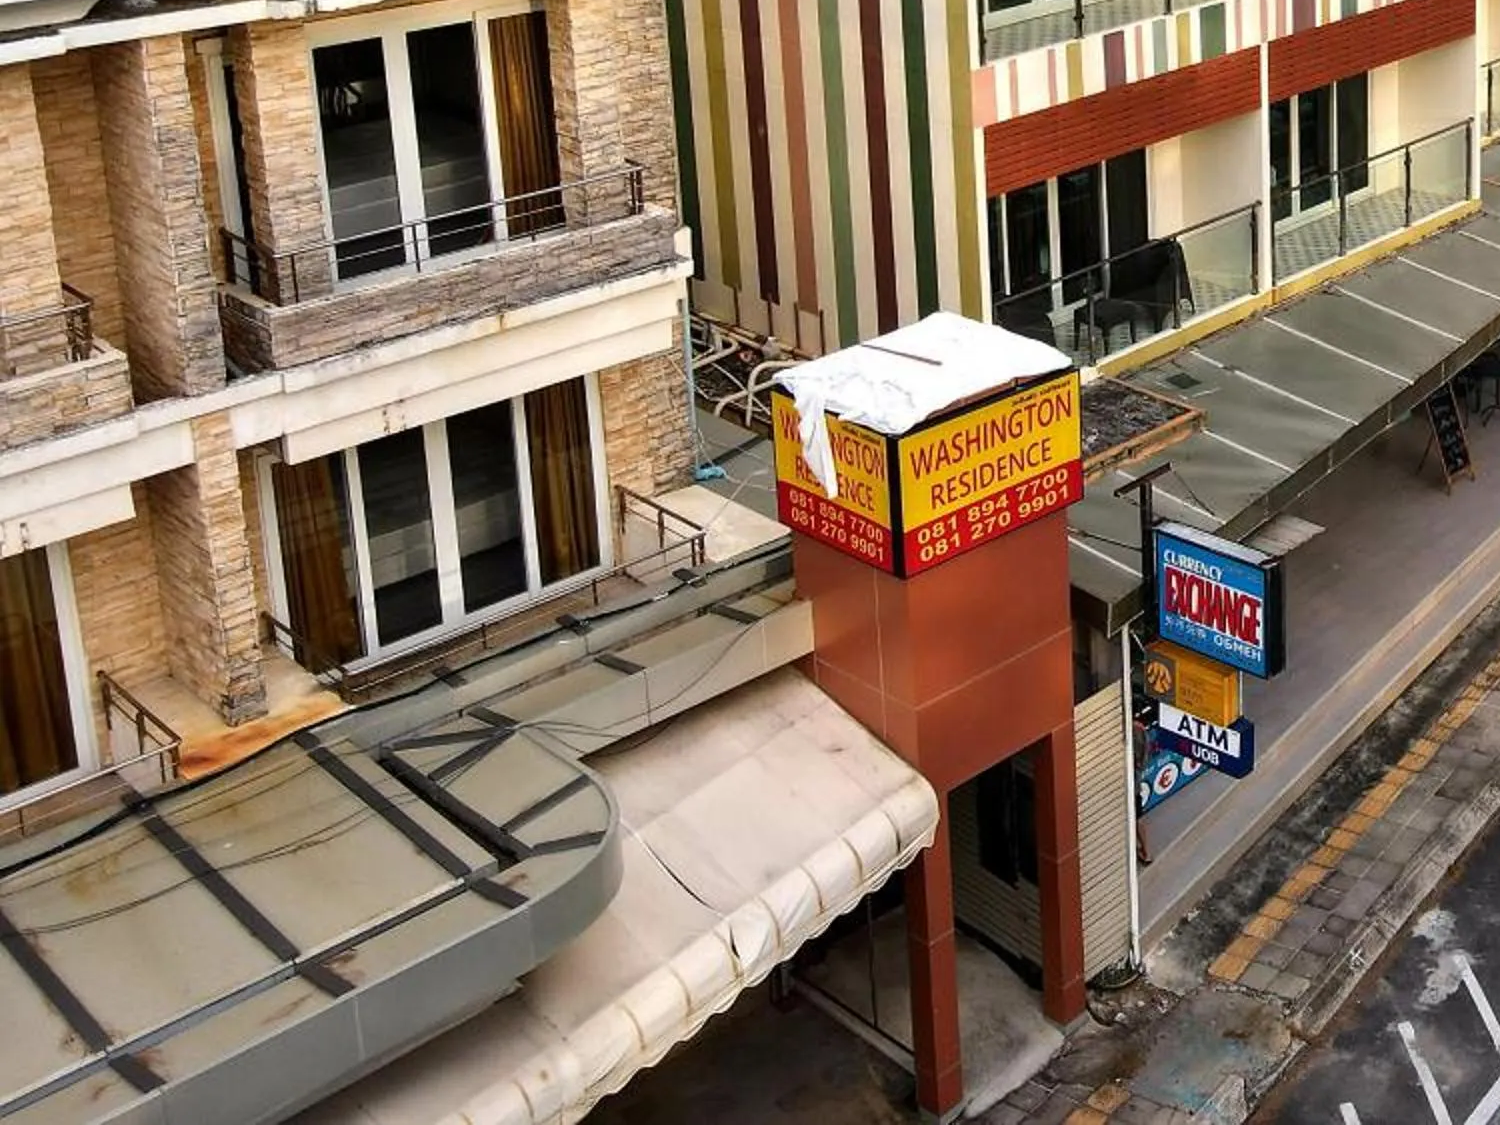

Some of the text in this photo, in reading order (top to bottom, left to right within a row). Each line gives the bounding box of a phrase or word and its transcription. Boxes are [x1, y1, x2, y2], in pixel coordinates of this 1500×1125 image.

[779, 406, 885, 481] WNGTON
[909, 390, 1072, 480] WASHINGTON
[930, 437, 1053, 510] RESIDENCE
[789, 487, 884, 543] 081 894 7700
[791, 508, 884, 562] 081 270 9901
[917, 468, 1069, 545] 081 894 7700
[919, 485, 1070, 562] 081 270 9901
[1163, 549, 1223, 581] CURRENCY
[1165, 566, 1261, 646] EXCHANGE
[1213, 634, 1261, 662] ОБМЕН
[1177, 713, 1229, 751] ATM
[1191, 743, 1219, 765] UOB
